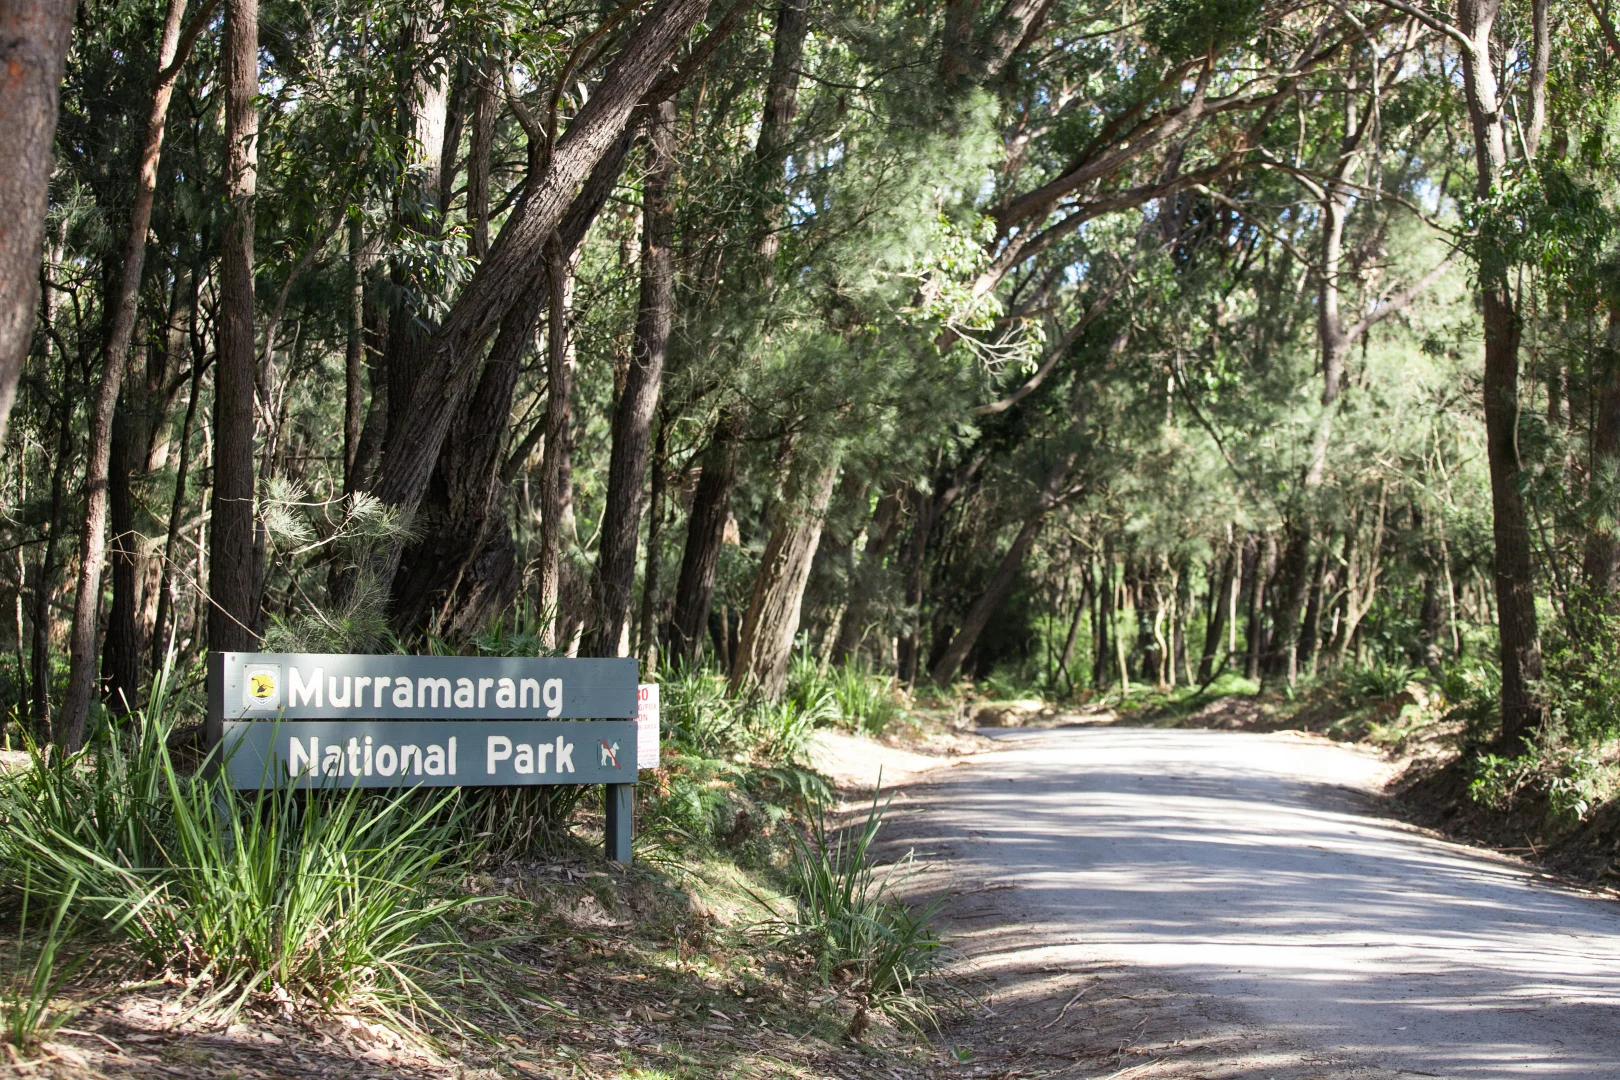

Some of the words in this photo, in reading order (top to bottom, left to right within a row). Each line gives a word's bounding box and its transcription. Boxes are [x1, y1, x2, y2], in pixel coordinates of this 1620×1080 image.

[288, 666, 563, 718] Murramarang
[289, 735, 456, 777] National
[487, 735, 575, 775] Park
